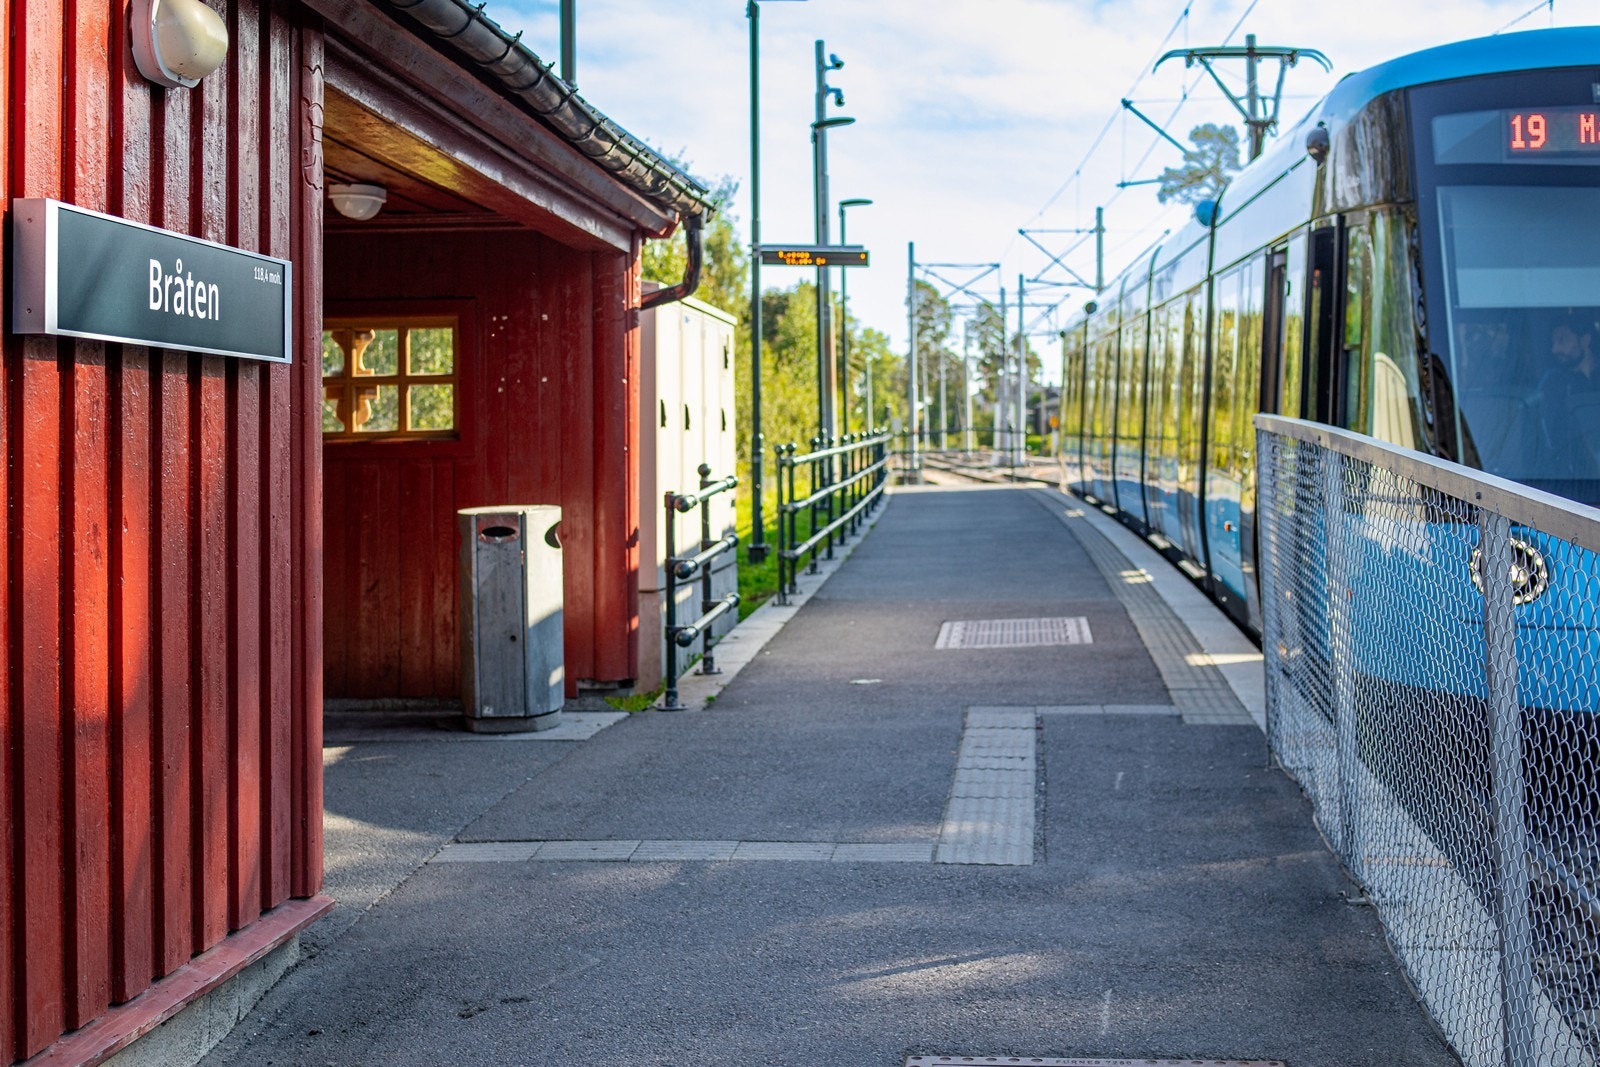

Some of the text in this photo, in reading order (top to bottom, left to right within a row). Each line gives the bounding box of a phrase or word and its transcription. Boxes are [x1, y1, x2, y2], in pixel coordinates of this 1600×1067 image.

[1511, 113, 1600, 148] 19 M
[149, 258, 219, 321] Bråten
[254, 266, 268, 282] 118,4
